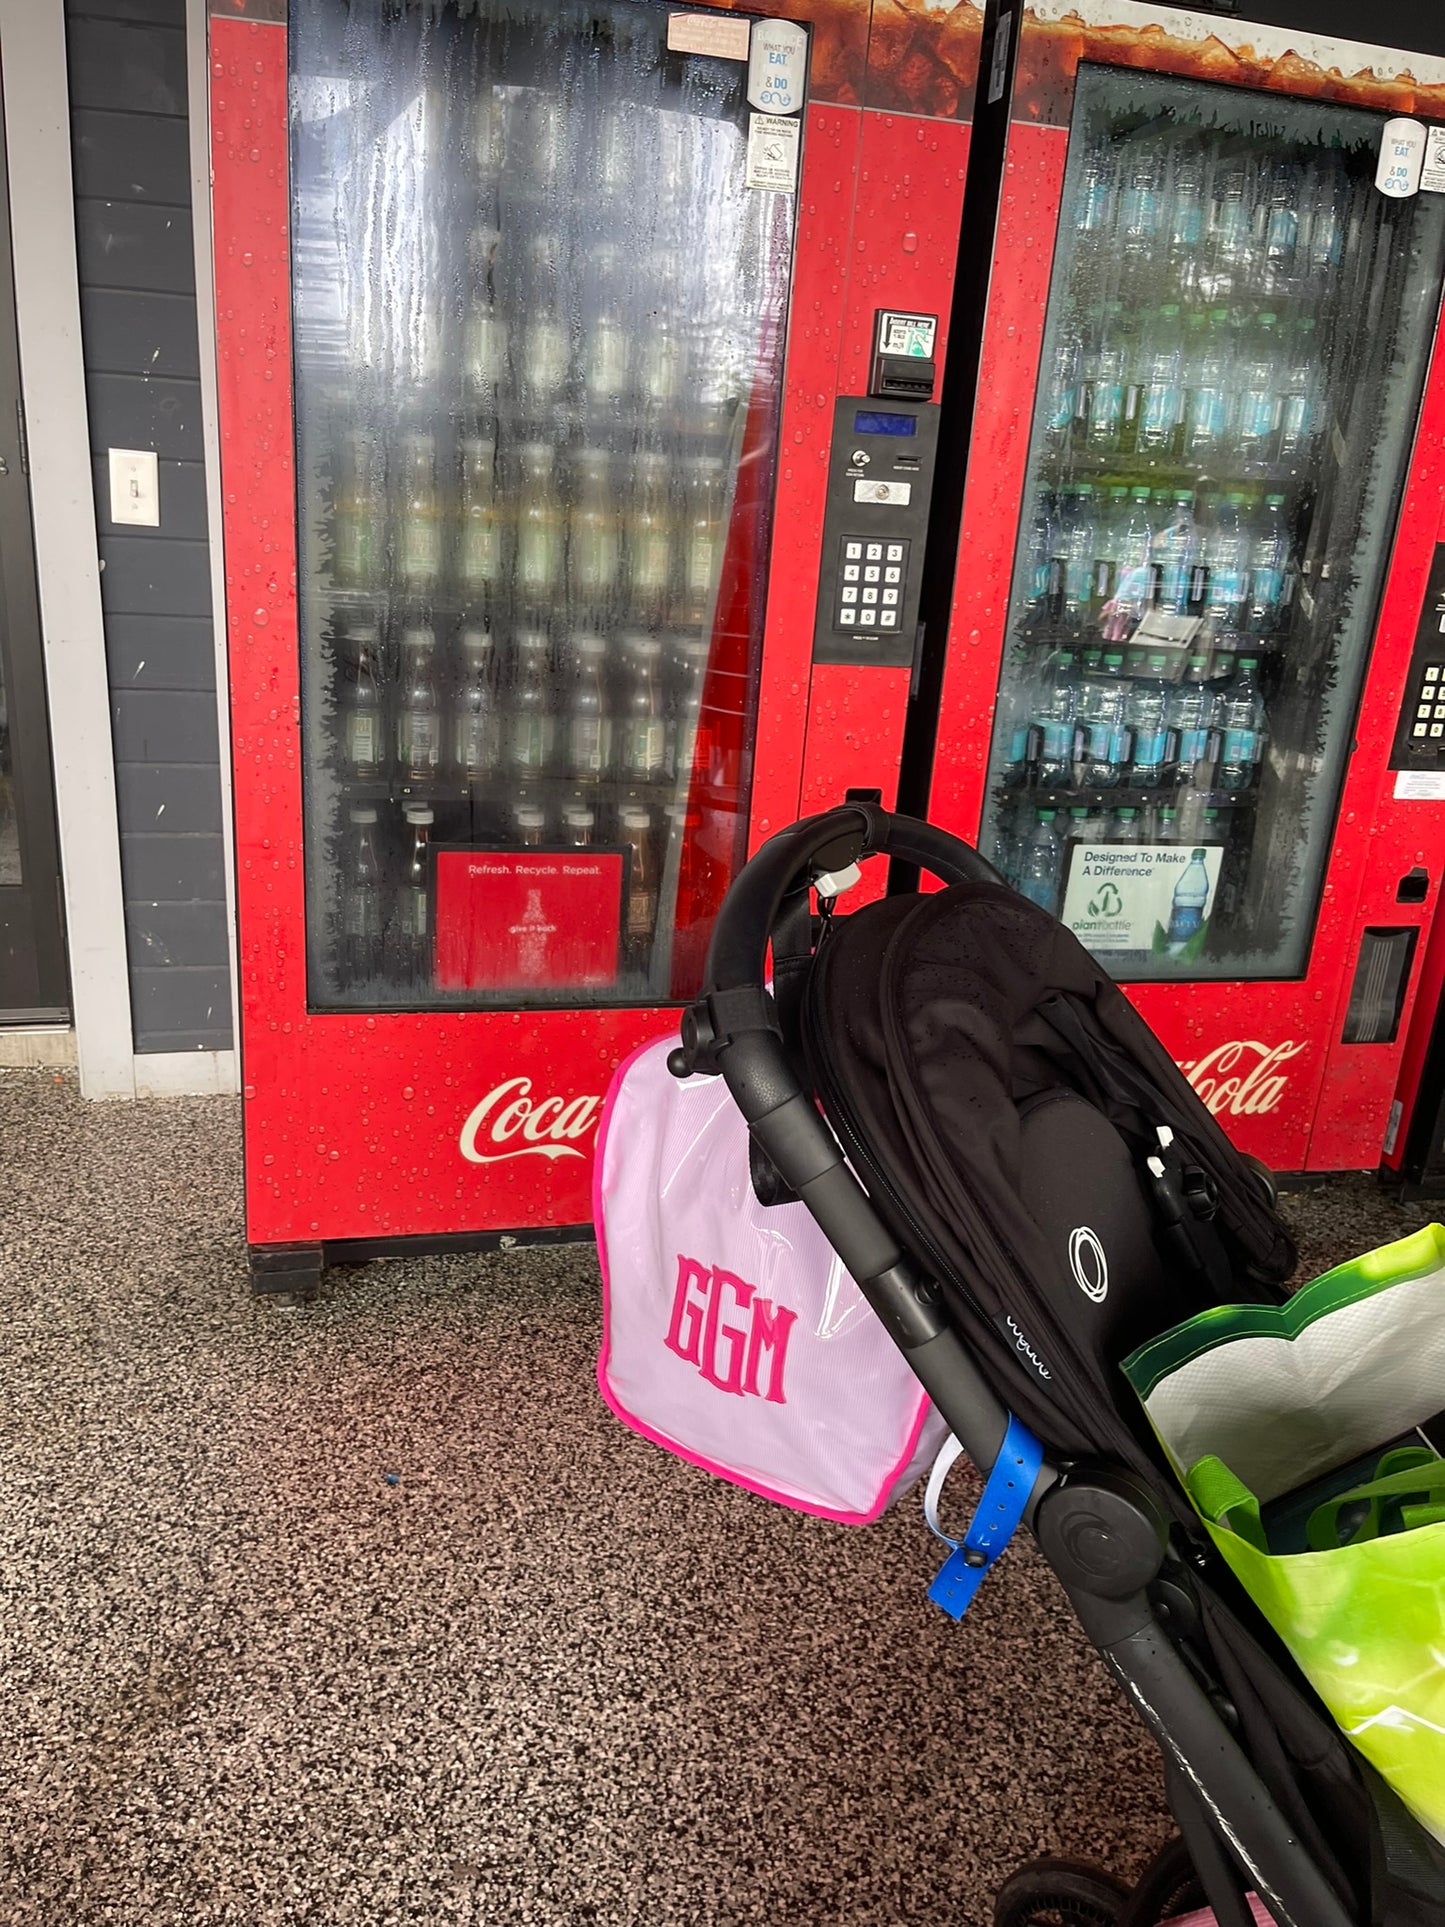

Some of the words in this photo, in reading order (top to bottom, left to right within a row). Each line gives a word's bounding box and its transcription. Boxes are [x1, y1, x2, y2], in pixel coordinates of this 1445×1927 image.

[763, 43, 781, 52] WHAT
[783, 44, 796, 55] YOU
[769, 52, 788, 65] EAT
[765, 76, 772, 88] &
[774, 77, 788, 89] DO
[766, 117, 798, 128] WARNING
[1394, 146, 1410, 157] EAT
[1396, 167, 1408, 177] DO
[872, 548, 878, 557] 2
[892, 549, 898, 557] 3
[849, 569, 855, 577] 4
[869, 570, 875, 578] 5
[890, 571, 896, 579] 6
[847, 591, 853, 599] 7
[867, 592, 873, 600] 8
[888, 592, 894, 601] 9
[865, 613, 871, 621] 0
[1084, 851, 1137, 864] Designed
[1140, 853, 1153, 863] To
[1155, 853, 1186, 864] Make
[468, 864, 511, 875] Refresh.
[515, 865, 559, 876] Recycle.
[562, 865, 602, 876] Repeat.
[1082, 867, 1092, 876] A
[1094, 865, 1153, 877] Difference
[508, 925, 527, 934] give
[663, 1253, 799, 1405] GGM
